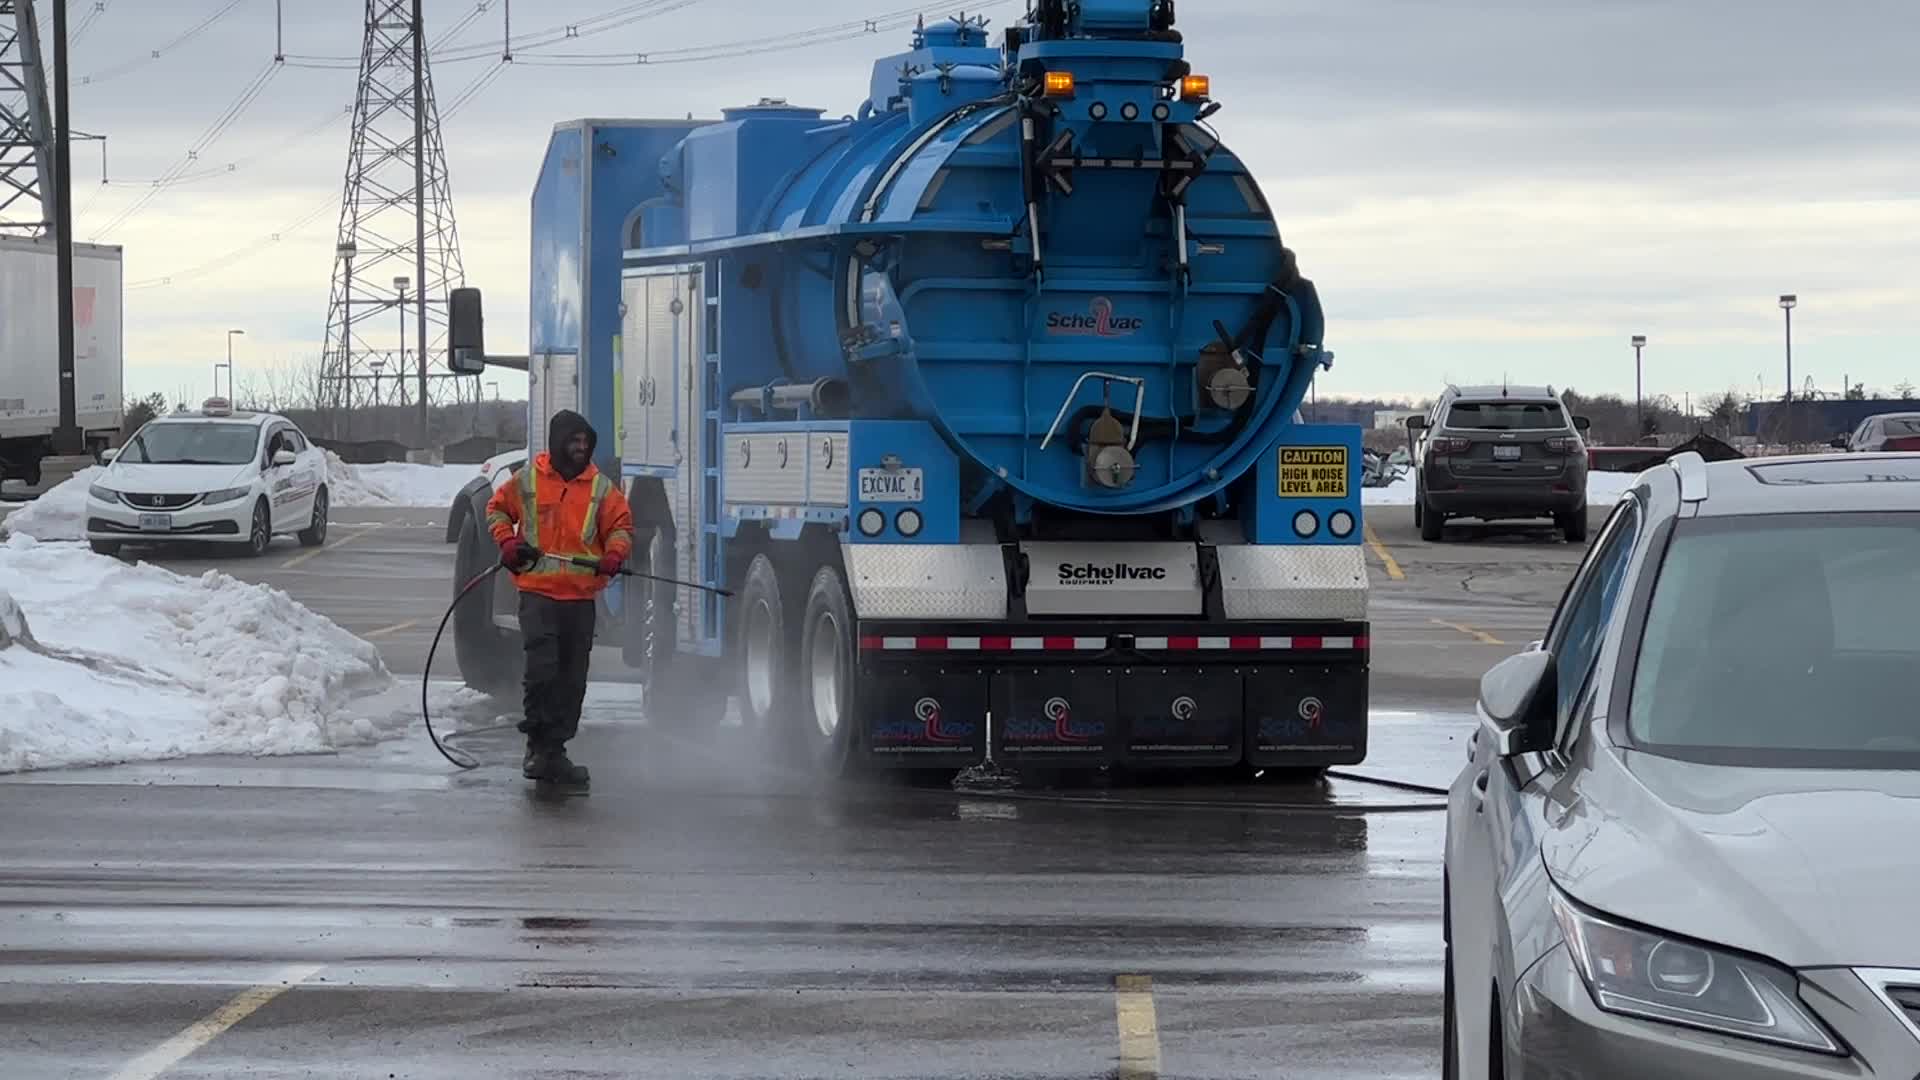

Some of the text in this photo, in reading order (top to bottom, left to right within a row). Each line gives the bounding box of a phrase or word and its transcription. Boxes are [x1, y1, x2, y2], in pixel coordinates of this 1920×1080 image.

[1283, 451, 1343, 463] CAUTION
[1282, 468, 1344, 480] HIGH NOISE
[862, 476, 921, 493] EXCVAC 4
[1281, 481, 1345, 493] LEVEL AREA
[1058, 563, 1166, 580] Schellvac
